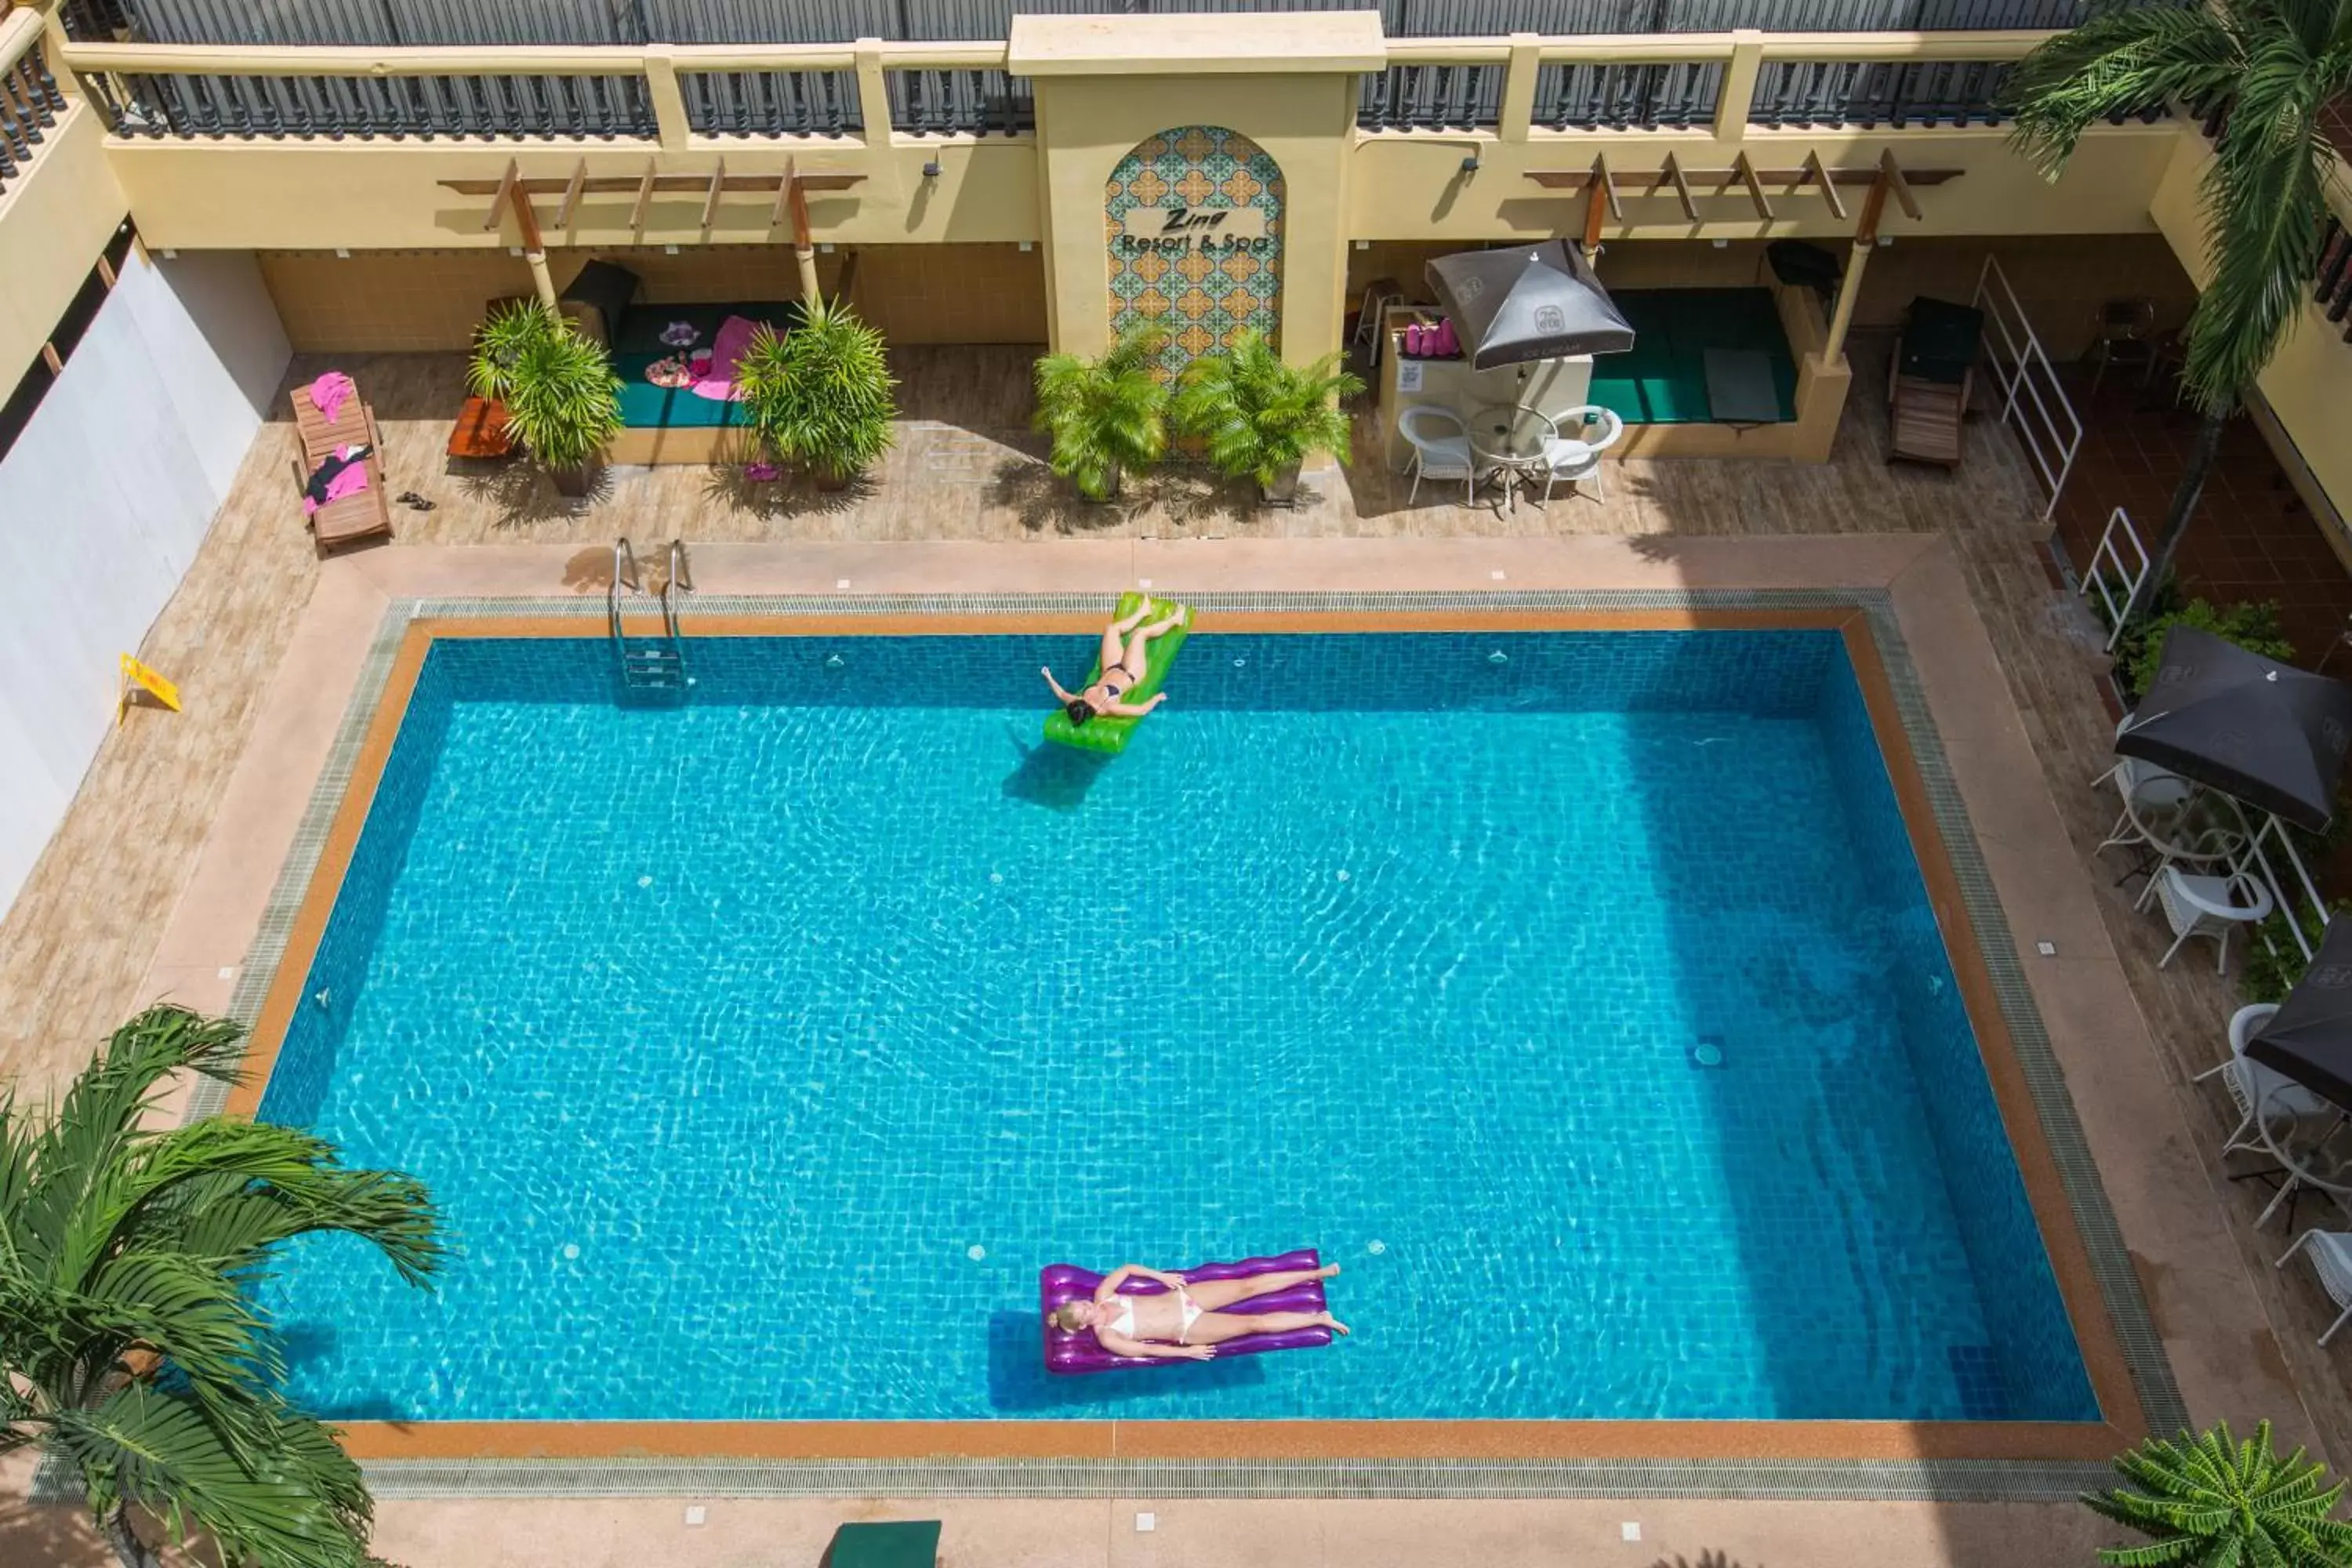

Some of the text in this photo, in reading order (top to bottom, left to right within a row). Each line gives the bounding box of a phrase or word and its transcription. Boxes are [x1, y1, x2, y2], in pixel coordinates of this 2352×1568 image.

[1123, 233, 1268, 252] Resort & Spa
